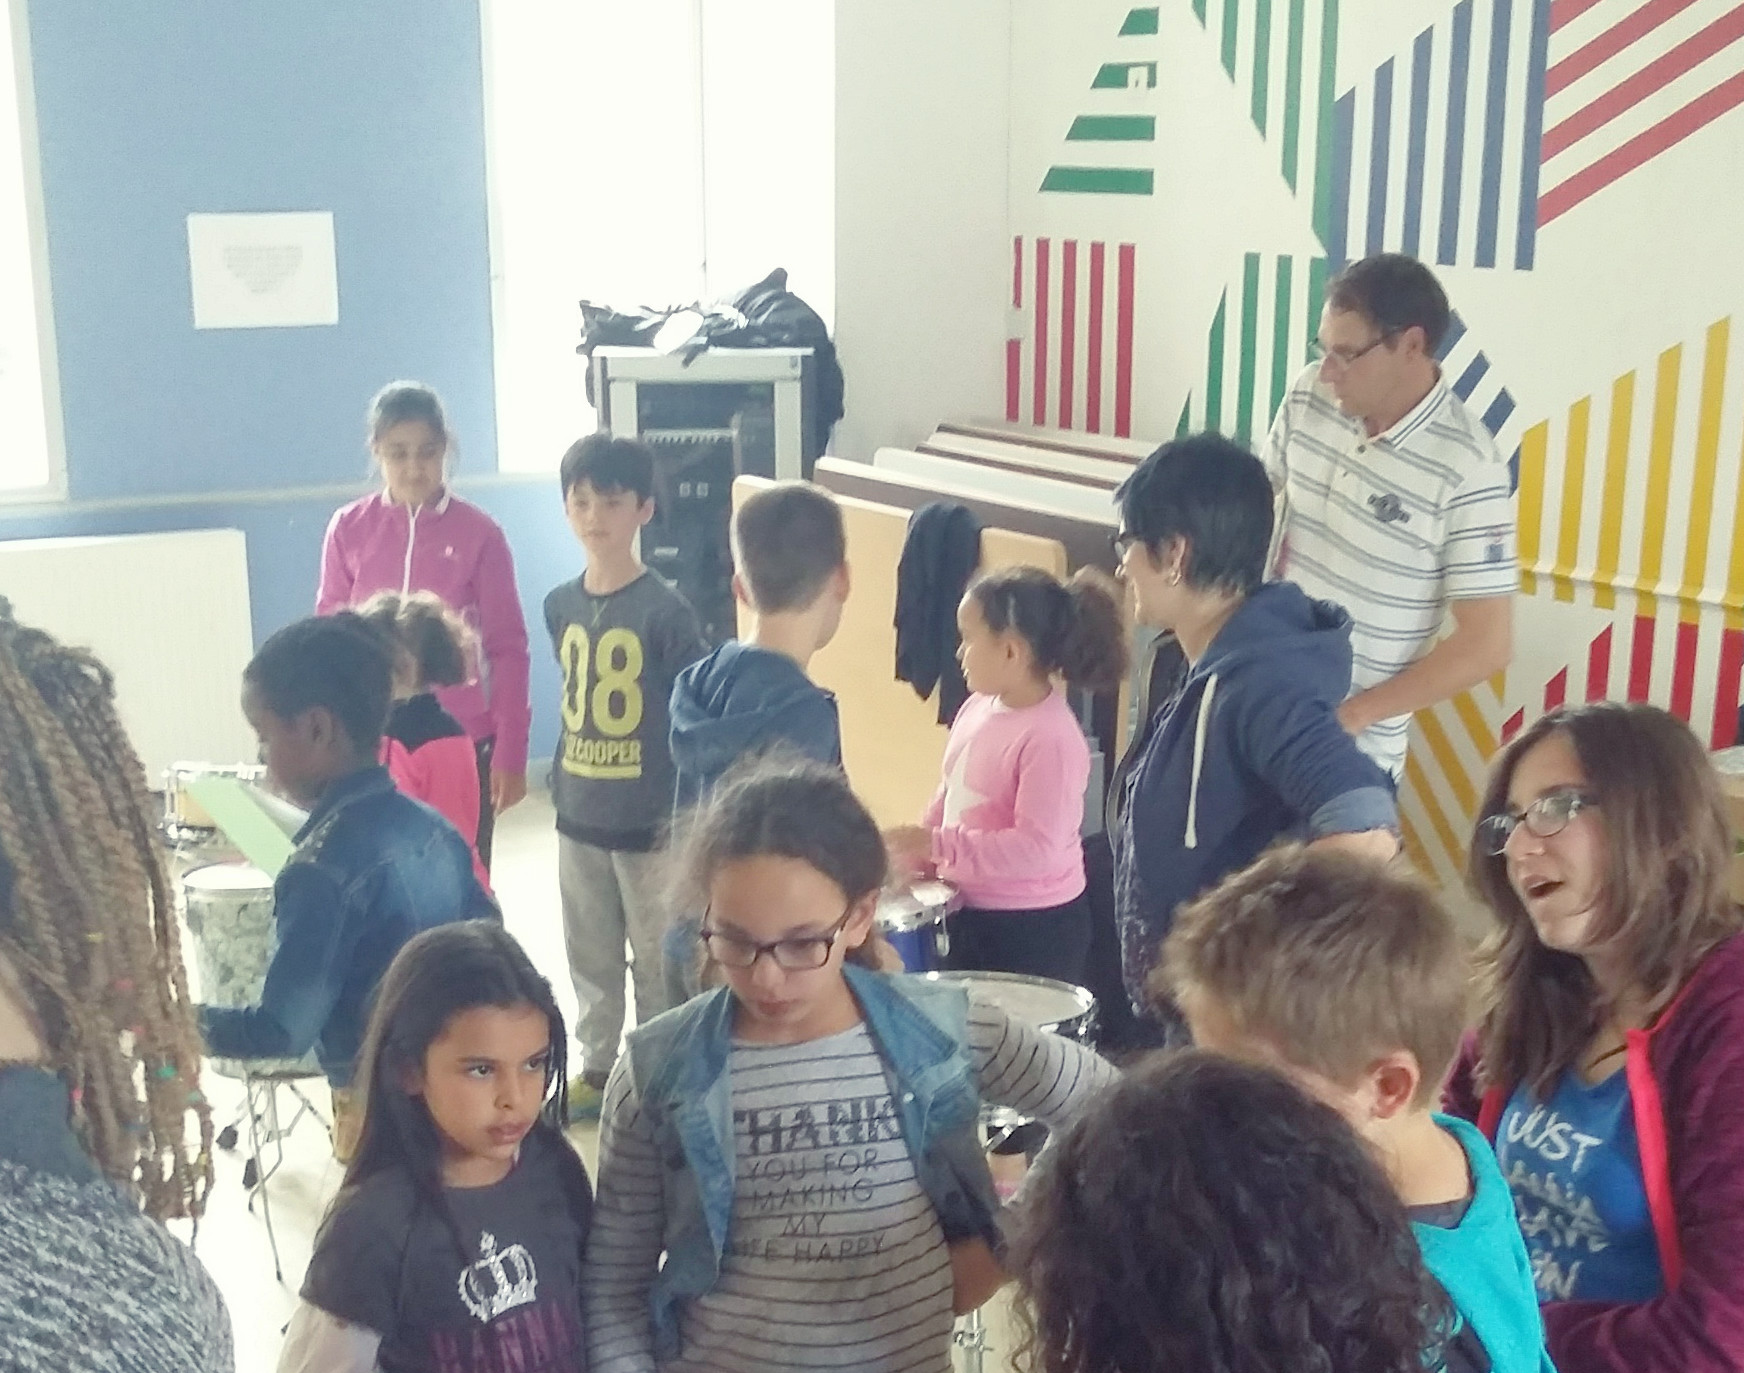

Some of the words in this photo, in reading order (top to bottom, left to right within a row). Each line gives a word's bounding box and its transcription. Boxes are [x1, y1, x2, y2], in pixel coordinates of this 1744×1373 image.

[560, 623, 643, 737] 08
[749, 1156, 806, 1183] YOU
[823, 1148, 880, 1177] FOR
[751, 1178, 875, 1212] MAKING
[782, 1212, 827, 1237] MY
[793, 1231, 887, 1263] HAPPY
